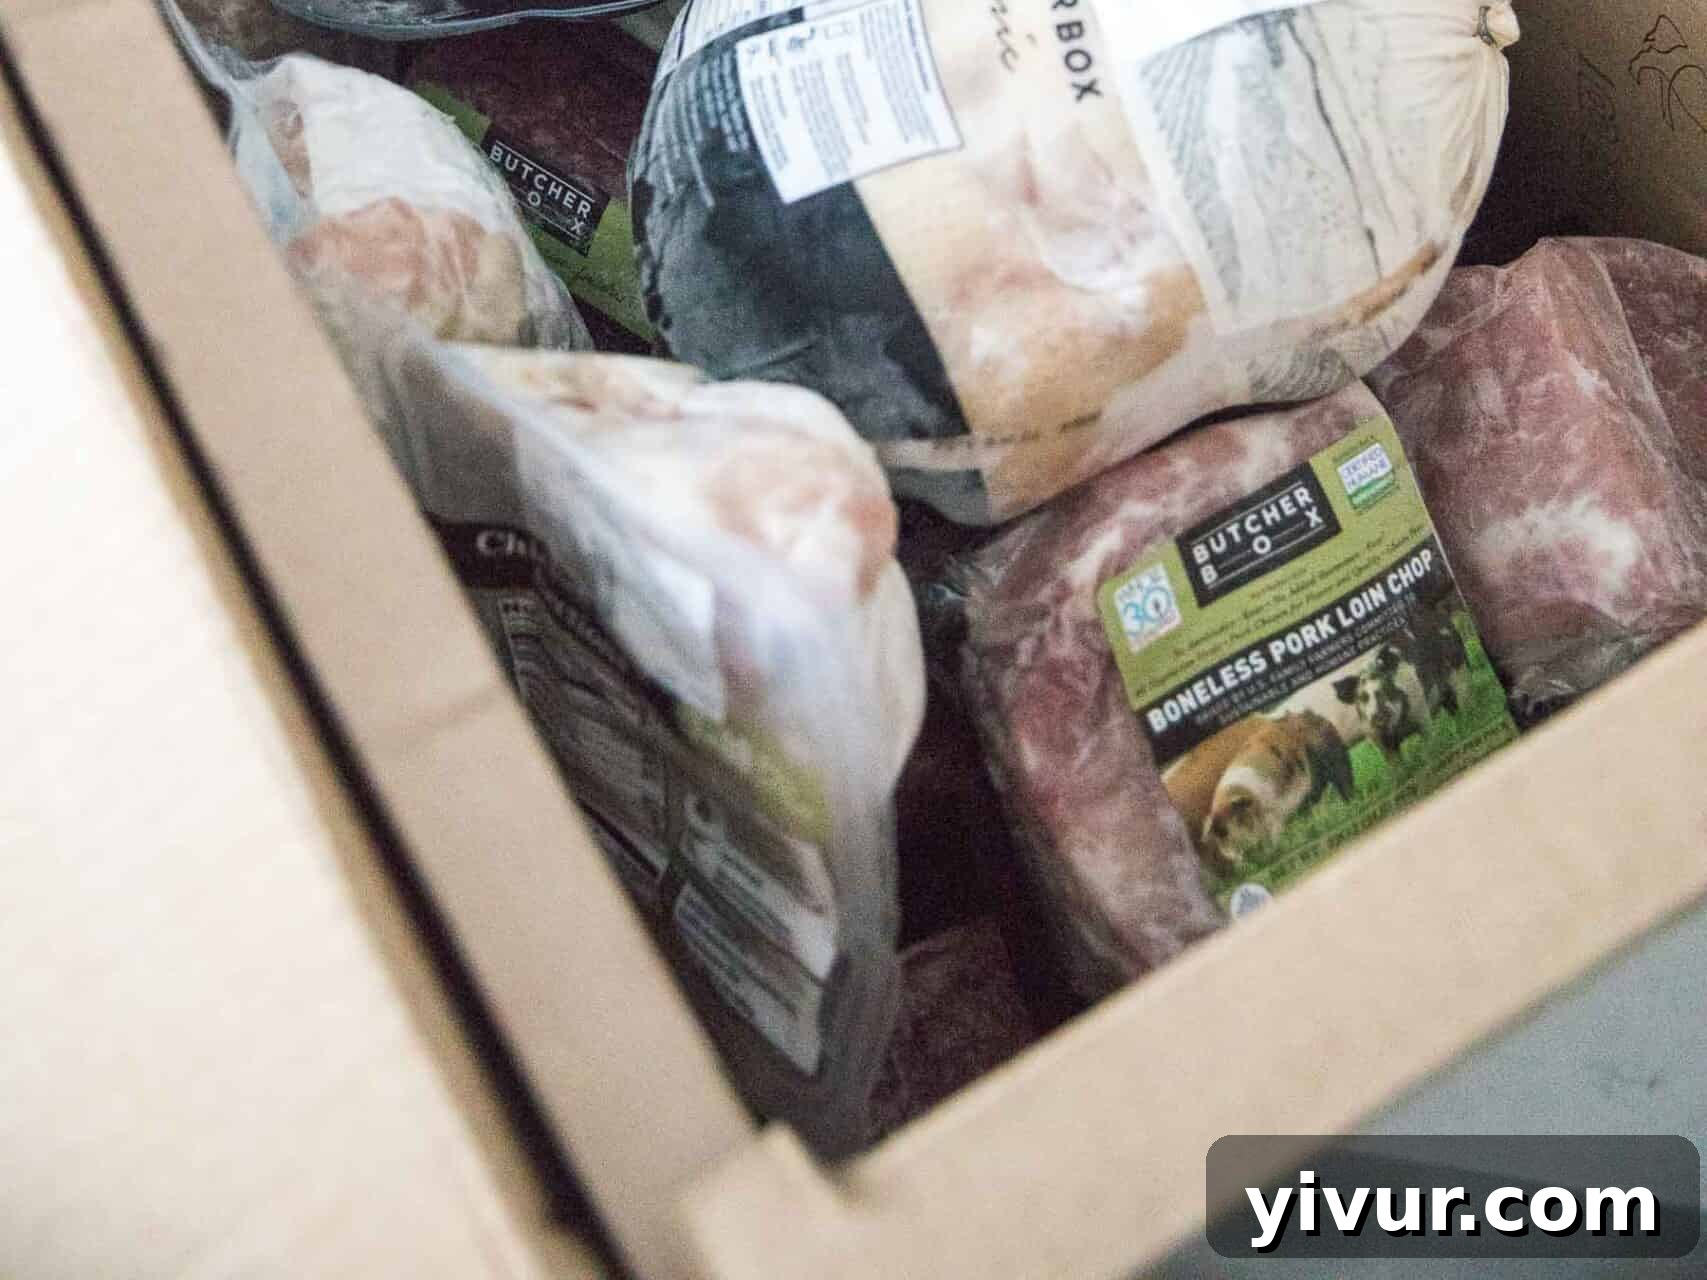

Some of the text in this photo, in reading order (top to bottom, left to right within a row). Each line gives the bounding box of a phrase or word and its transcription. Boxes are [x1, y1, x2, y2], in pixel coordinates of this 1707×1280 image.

[490, 145, 593, 220] BUTCHER
[1192, 486, 1314, 565] BUTCHER
[1145, 650, 1268, 735] BONELESS
[1269, 614, 1338, 665] PORK
[1337, 581, 1388, 628] LOIN
[1387, 548, 1434, 596] CHOP
